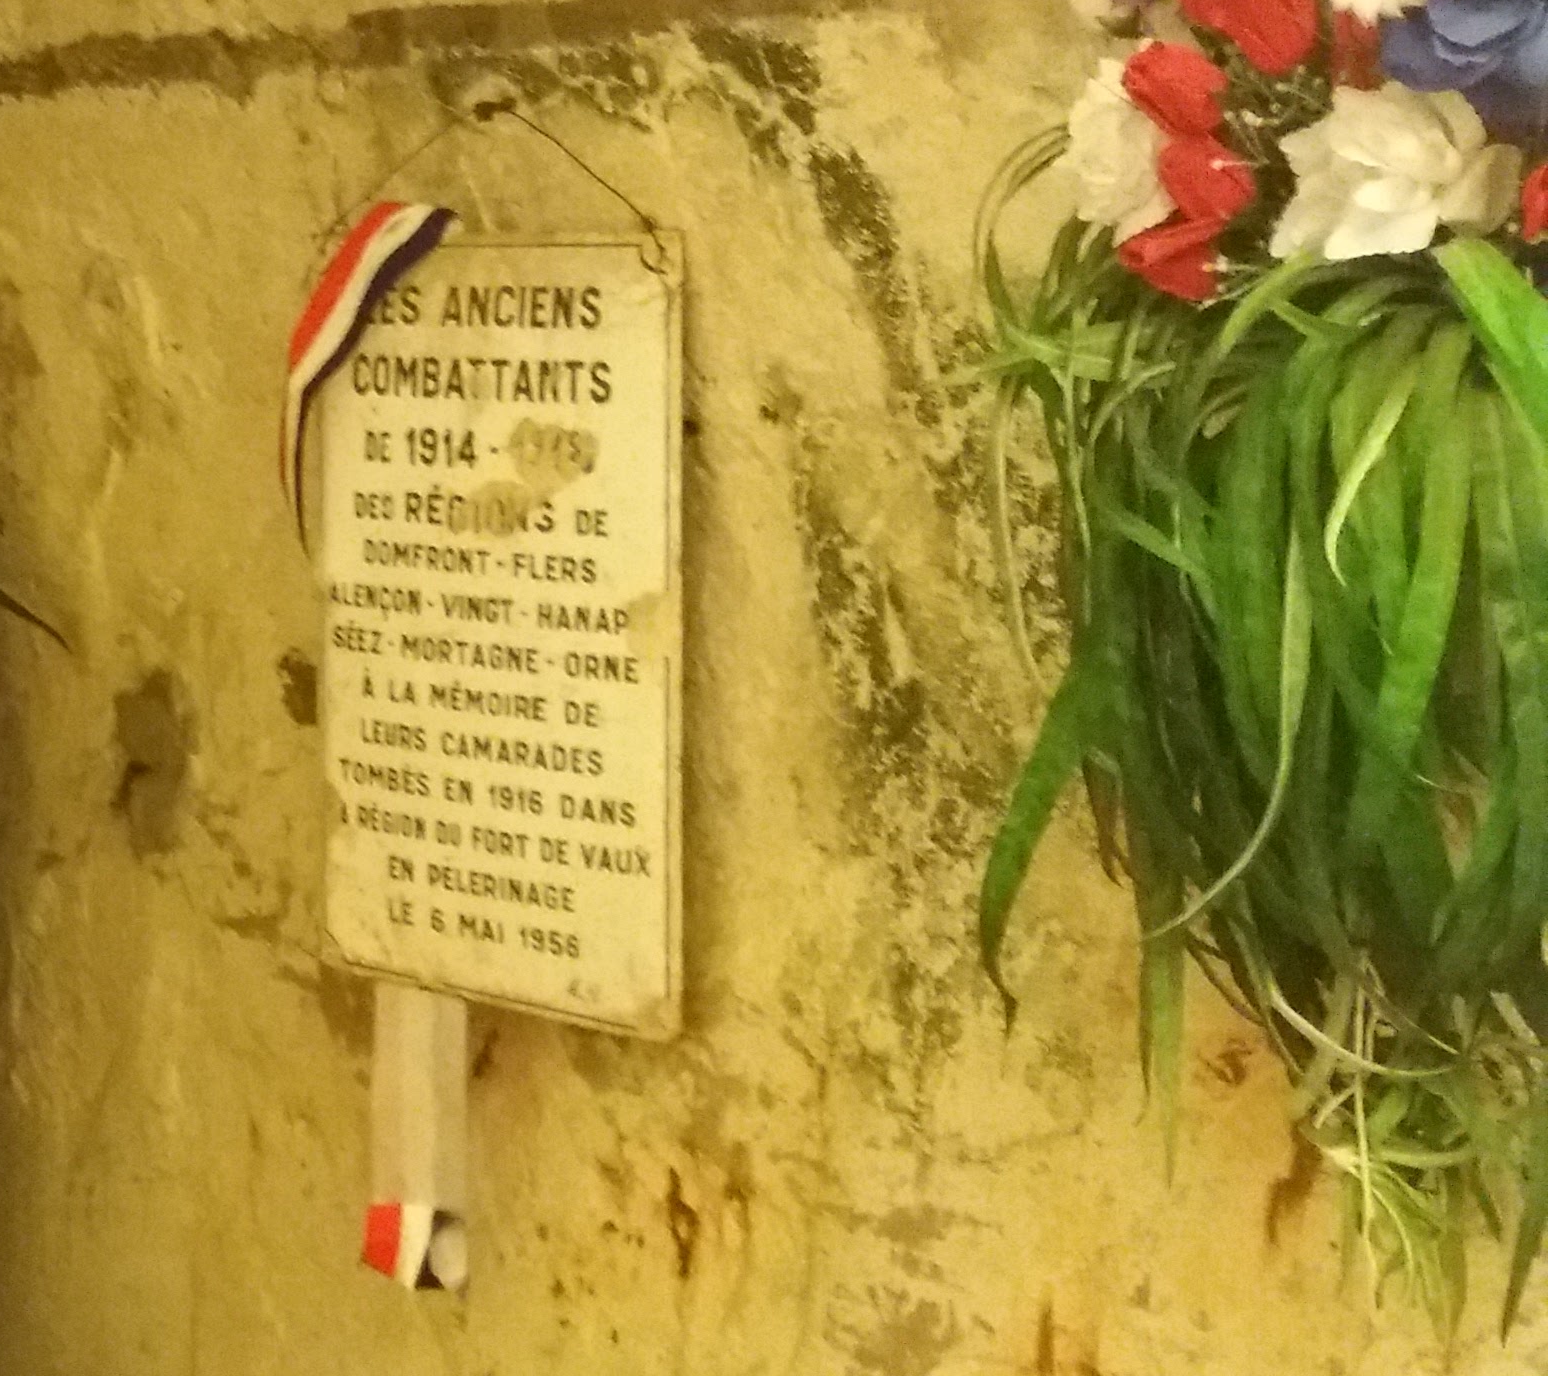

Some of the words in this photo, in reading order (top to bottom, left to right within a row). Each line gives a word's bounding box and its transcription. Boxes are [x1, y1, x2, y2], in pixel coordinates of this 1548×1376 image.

[366, 285, 421, 326] ES
[441, 285, 602, 329] ANCIENS
[353, 352, 614, 404] COMBATTANTS
[363, 430, 391, 463] DE
[405, 428, 477, 469] 1914
[575, 508, 609, 538] DE
[363, 538, 491, 574] DOMFRONT
[512, 552, 598, 584] FLERS
[329, 581, 422, 622] ALENÇON
[441, 592, 515, 627] VINGT
[536, 601, 630, 636] HANAP
[400, 634, 539, 674] MORTAGNE
[564, 650, 639, 685] ORNE
[388, 678, 416, 705] LA
[565, 699, 601, 728] DE
[360, 718, 428, 752] LEURS
[441, 730, 604, 777] CAMARADES
[445, 775, 474, 806] EN
[559, 792, 638, 829] DANS
[388, 854, 414, 883] EN
[473, 824, 529, 860] FORT
[539, 835, 570, 866] DE
[579, 842, 652, 878] VAUX
[388, 896, 415, 926] LE
[458, 912, 505, 945] MAI
